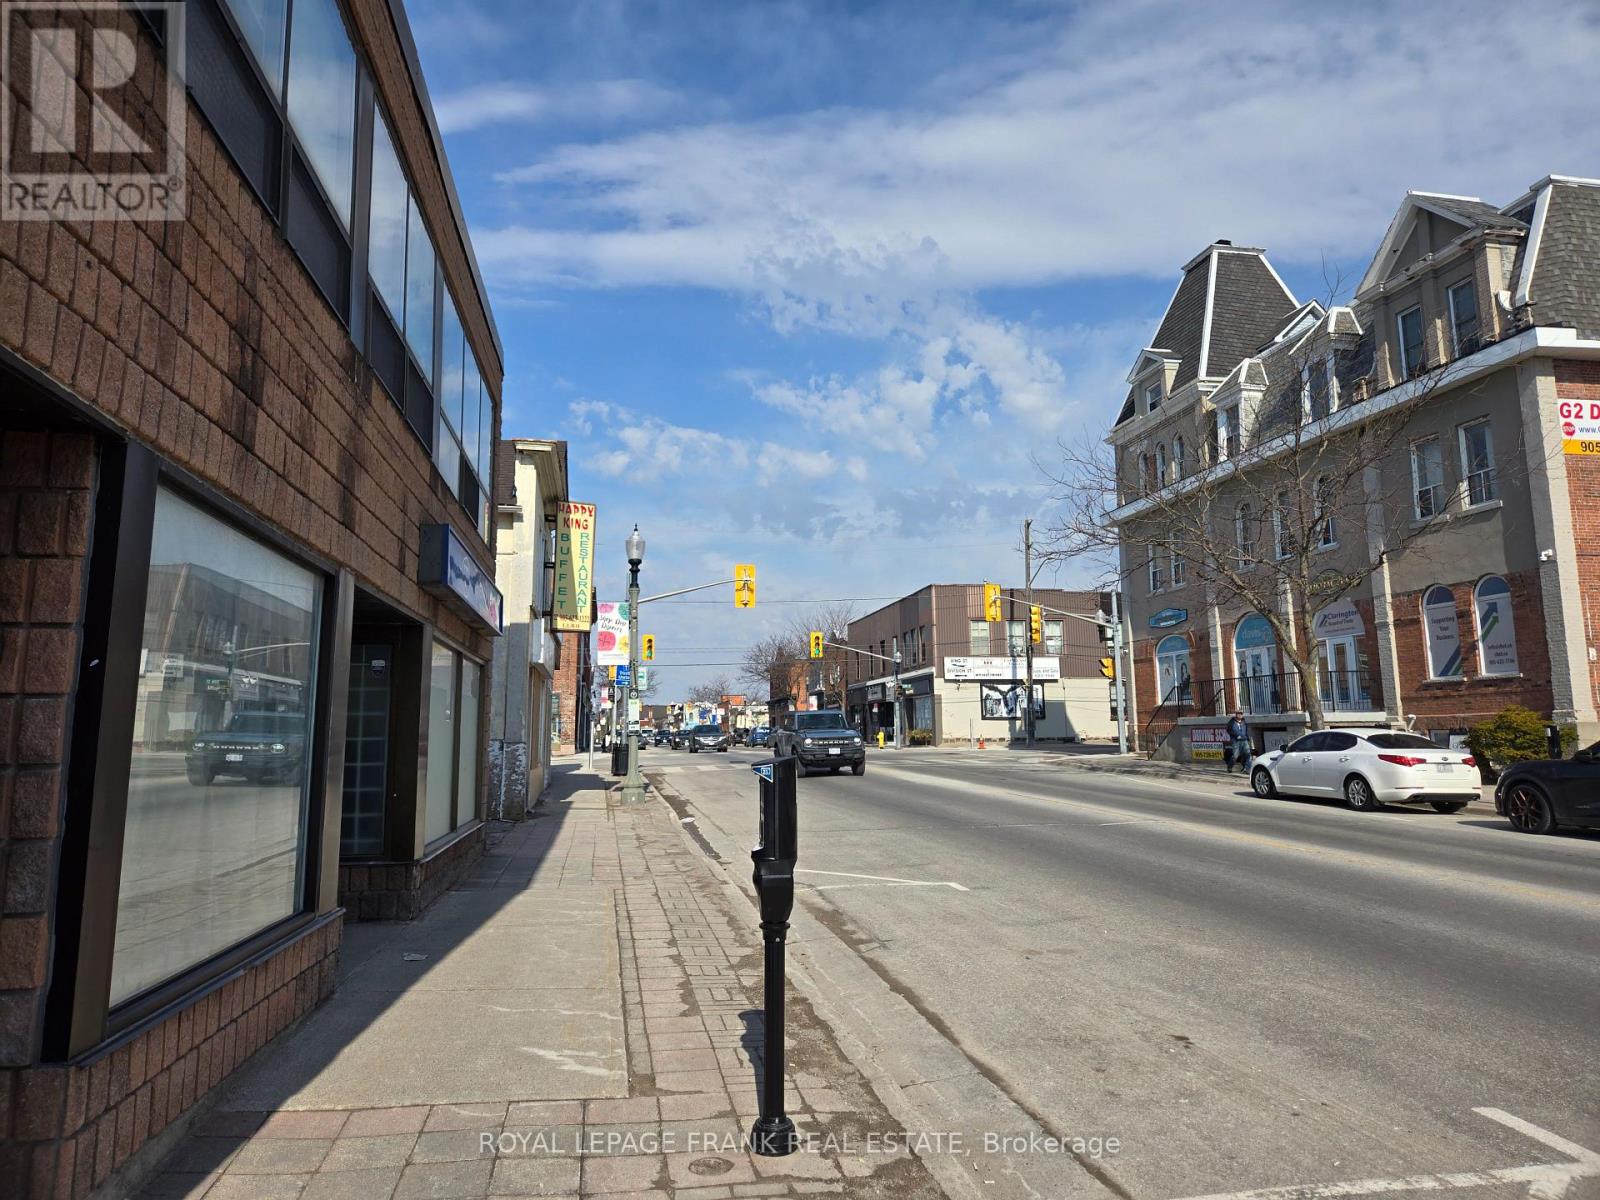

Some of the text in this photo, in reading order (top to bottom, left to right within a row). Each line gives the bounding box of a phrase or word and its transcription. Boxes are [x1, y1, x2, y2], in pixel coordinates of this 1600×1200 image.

[1560, 402, 1583, 419] G2
[558, 503, 594, 517] HAPPY
[563, 517, 589, 530] KING
[557, 532, 570, 609] BUFFET
[576, 532, 590, 614] RESTAURANT
[1327, 610, 1359, 620] Clarington
[1431, 616, 1455, 624] Supporting
[1192, 729, 1214, 742] DRIVING
